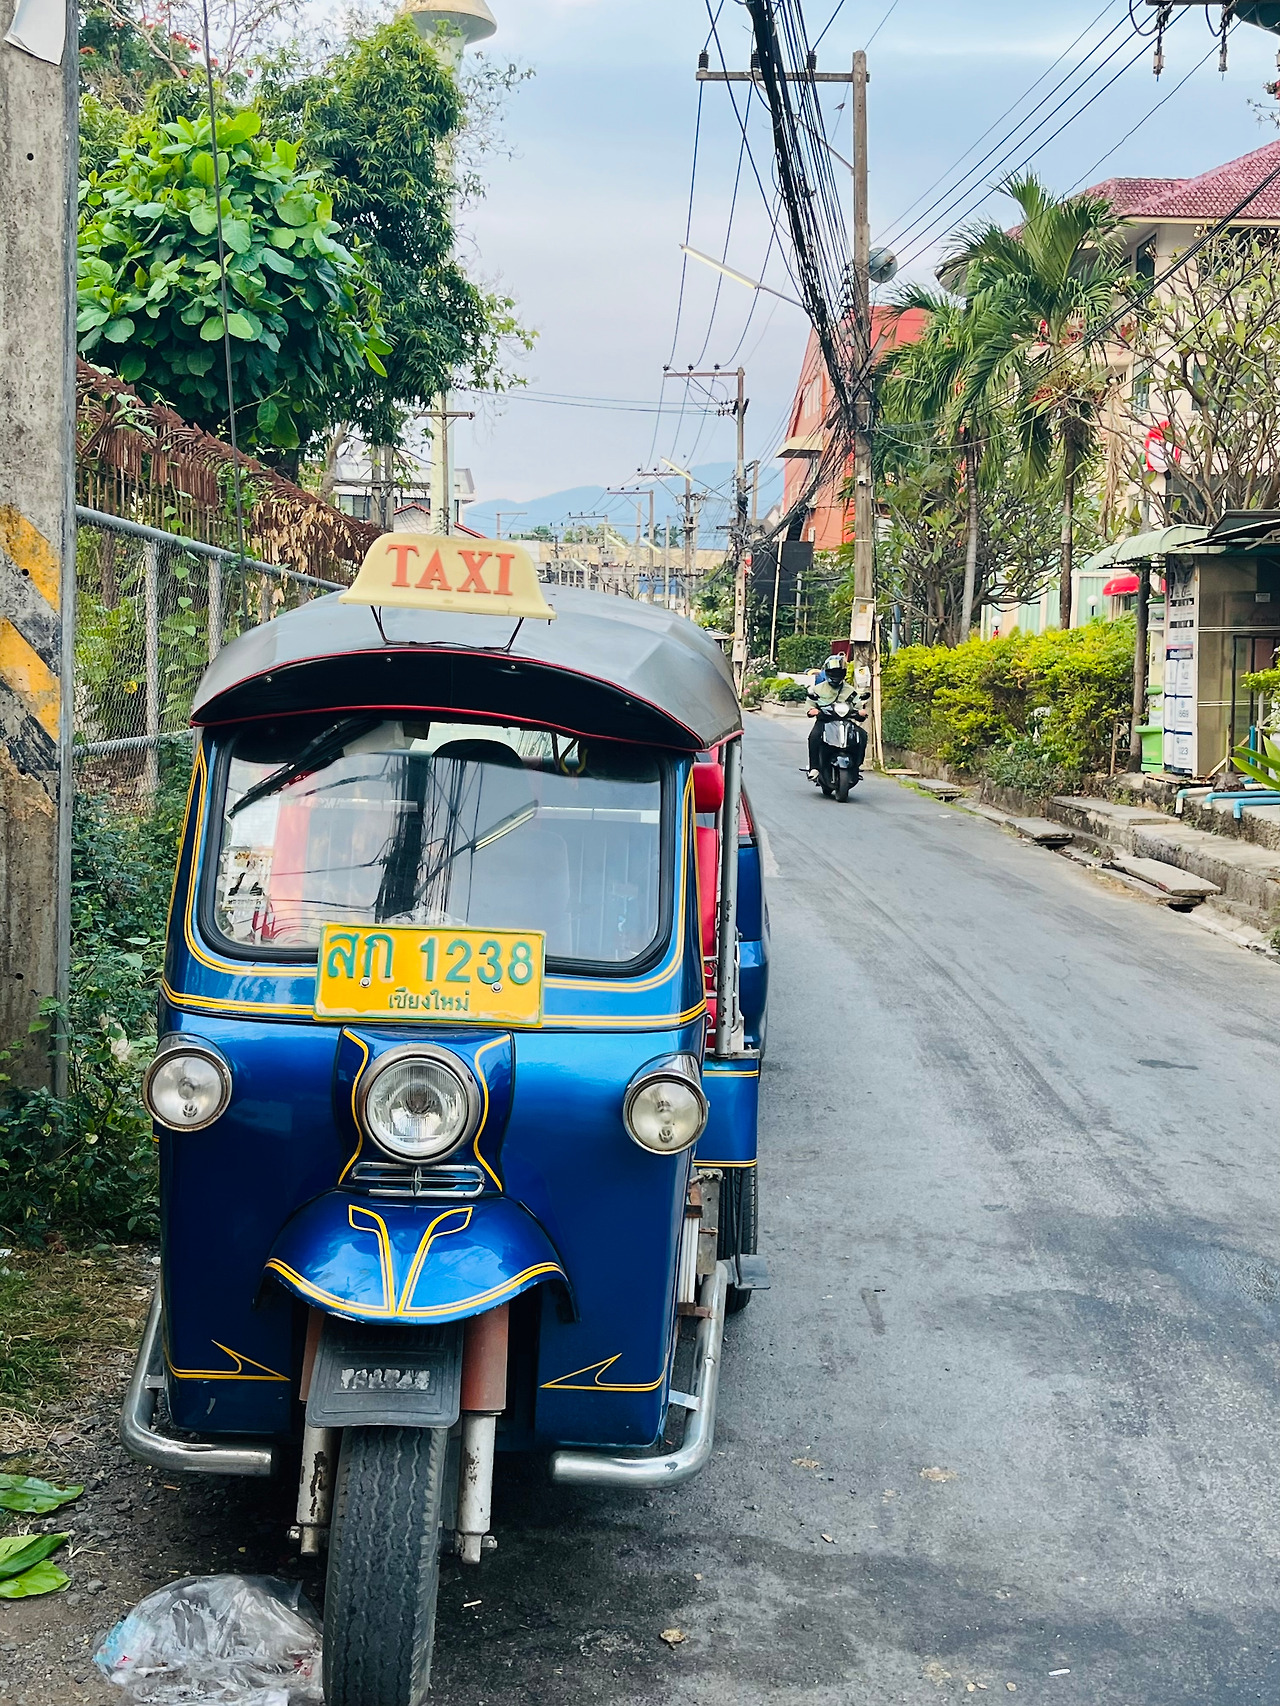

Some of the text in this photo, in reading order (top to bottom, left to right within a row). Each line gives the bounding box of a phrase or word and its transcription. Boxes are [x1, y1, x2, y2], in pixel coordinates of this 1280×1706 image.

[385, 544, 515, 596] TAXI
[327, 932, 533, 985] สก 1238
[388, 987, 470, 1011] เชียงใหม่
